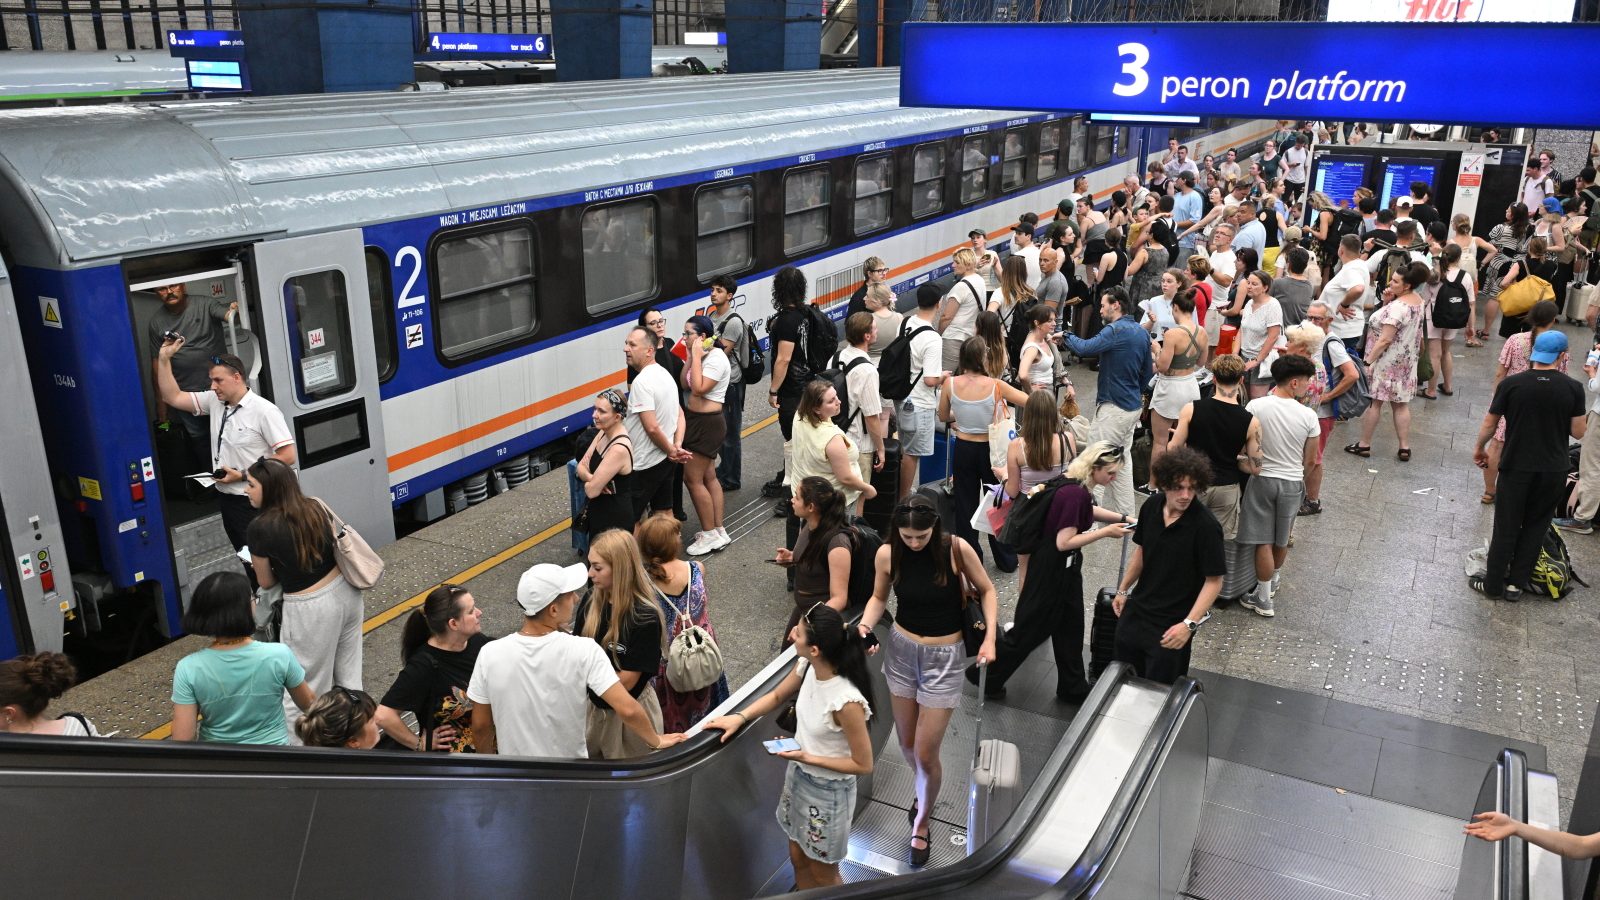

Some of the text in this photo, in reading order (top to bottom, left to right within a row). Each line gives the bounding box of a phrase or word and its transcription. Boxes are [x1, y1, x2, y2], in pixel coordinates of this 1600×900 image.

[1405, 0, 1474, 20] Hut
[170, 33, 177, 45] 8
[431, 35, 478, 52] 4 peron platform
[535, 37, 545, 51] 6
[1112, 42, 1407, 106] 3 peron platform
[439, 202, 526, 227] WAGON Z MIEJSCAMI LEŻĄCYMI
[395, 245, 425, 309] 2
[212, 283, 223, 296] 344
[310, 332, 322, 345] 344
[53, 373, 76, 388] 134Ab
